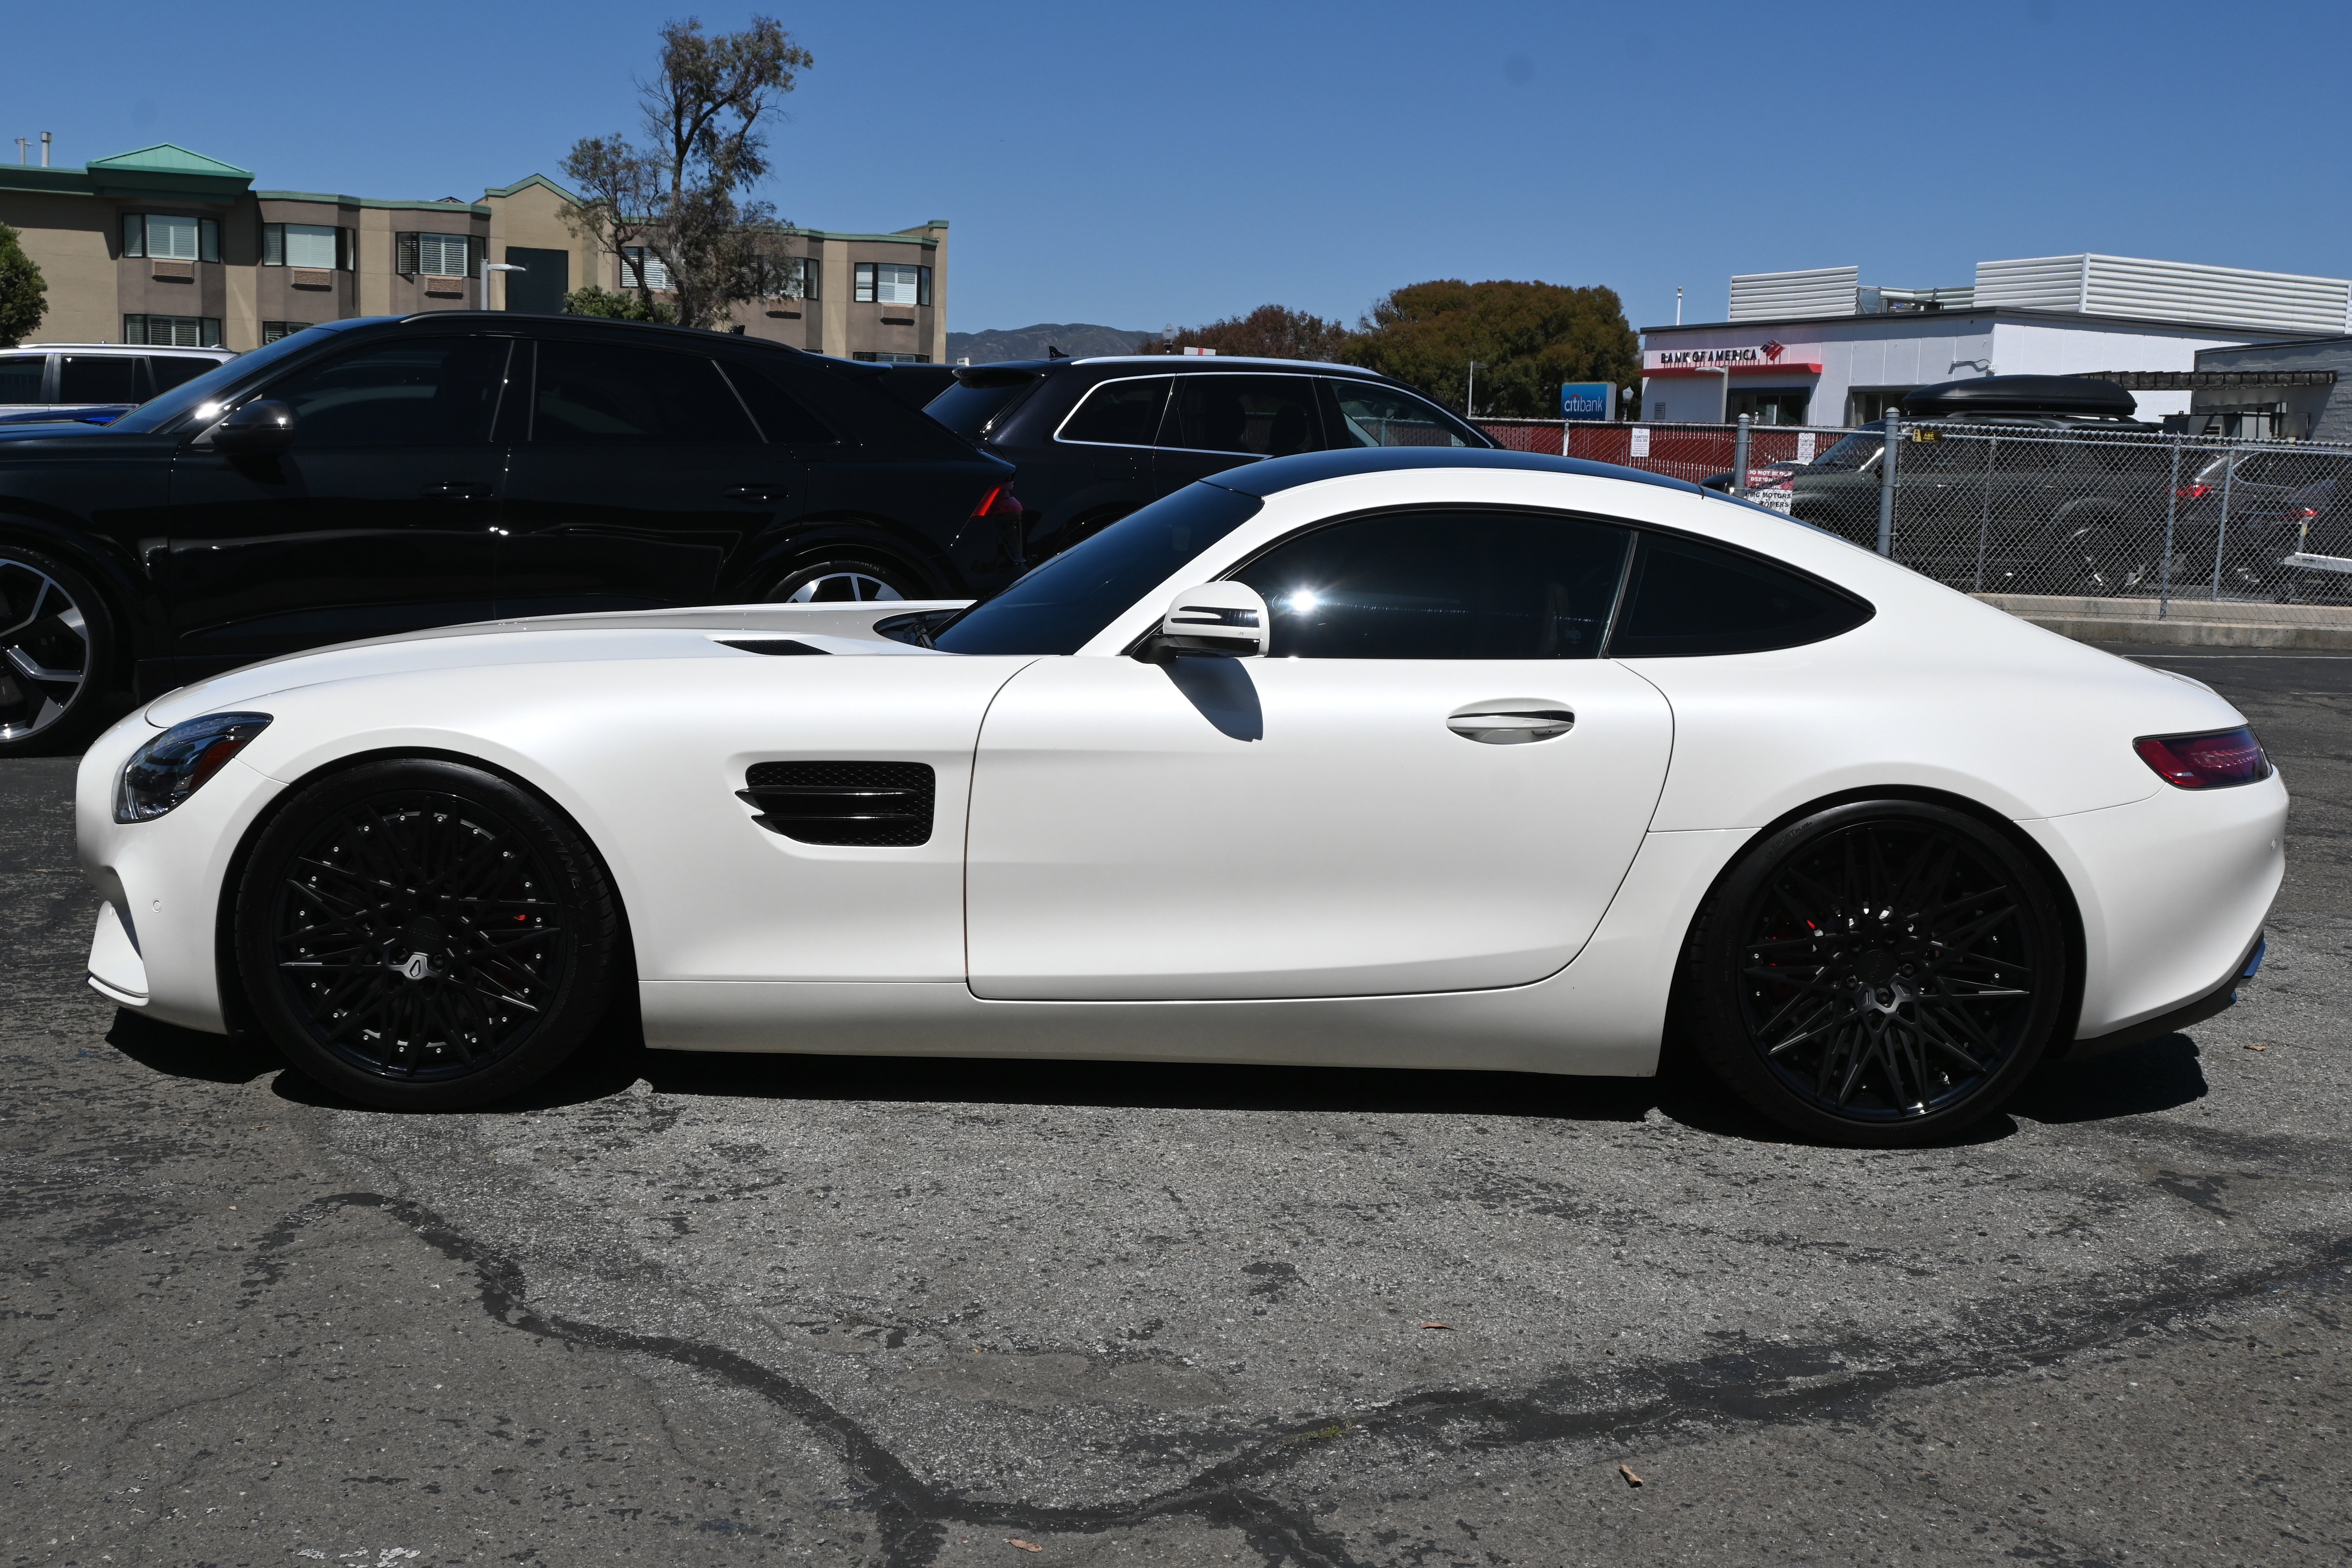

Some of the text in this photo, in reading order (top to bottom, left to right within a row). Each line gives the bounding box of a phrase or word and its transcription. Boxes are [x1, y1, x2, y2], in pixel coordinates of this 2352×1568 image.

[1661, 349, 1757, 363] BANK OF AMERICA
[1564, 395, 1603, 412] citibank
